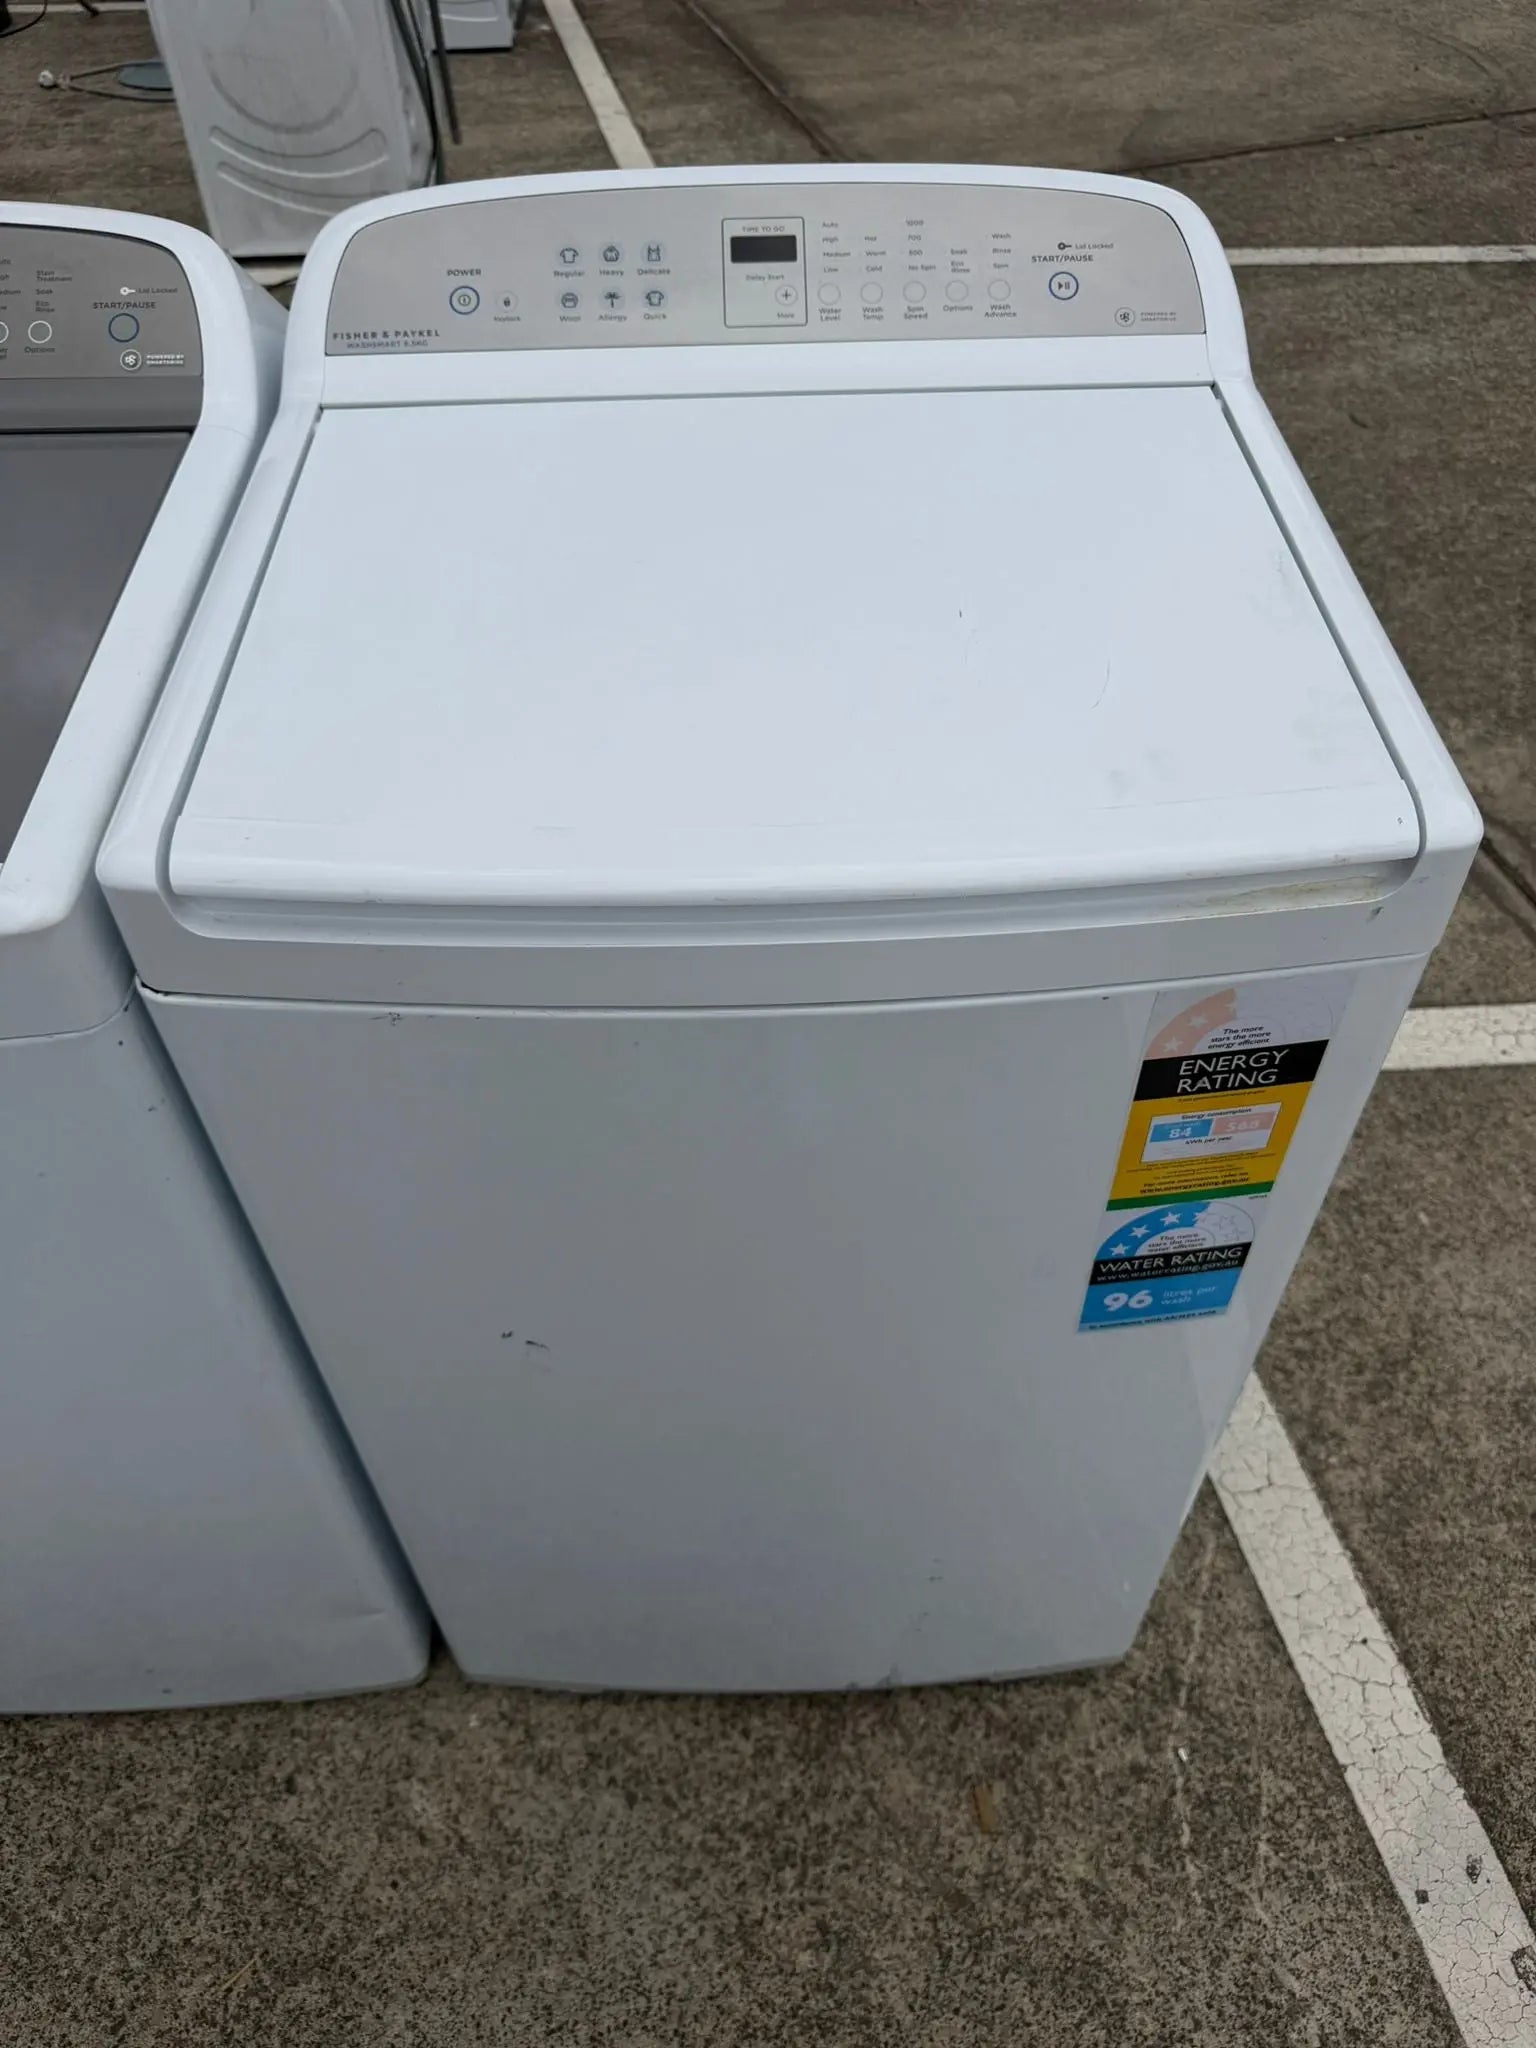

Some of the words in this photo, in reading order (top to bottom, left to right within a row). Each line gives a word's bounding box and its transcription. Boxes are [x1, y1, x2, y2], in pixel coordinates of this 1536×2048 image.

[1031, 254, 1094, 263] START/PAUSE
[446, 268, 482, 277] POWER
[553, 270, 585, 278] Regular
[599, 269, 624, 277] Heavy
[93, 302, 156, 310] START/PAUSE
[332, 331, 378, 340] FISHER
[395, 329, 440, 338] PAYKEL
[347, 340, 400, 348] WASHSMART
[1207, 1042, 1238, 1050] energy
[1238, 1038, 1270, 1046] efficient
[1210, 1035, 1232, 1043] stars
[1179, 1048, 1290, 1076] ENERGY
[1176, 1069, 1279, 1094] RATING
[1168, 1126, 1193, 1140] 84
[1098, 1254, 1165, 1272] WATER
[1171, 1247, 1243, 1266] RATING
[1097, 1260, 1240, 1282] www.waterrating.gov.au
[1162, 1288, 1193, 1298] litres
[1196, 1286, 1218, 1296] per
[1103, 1289, 1154, 1312] 96
[1161, 1296, 1192, 1306] wash
